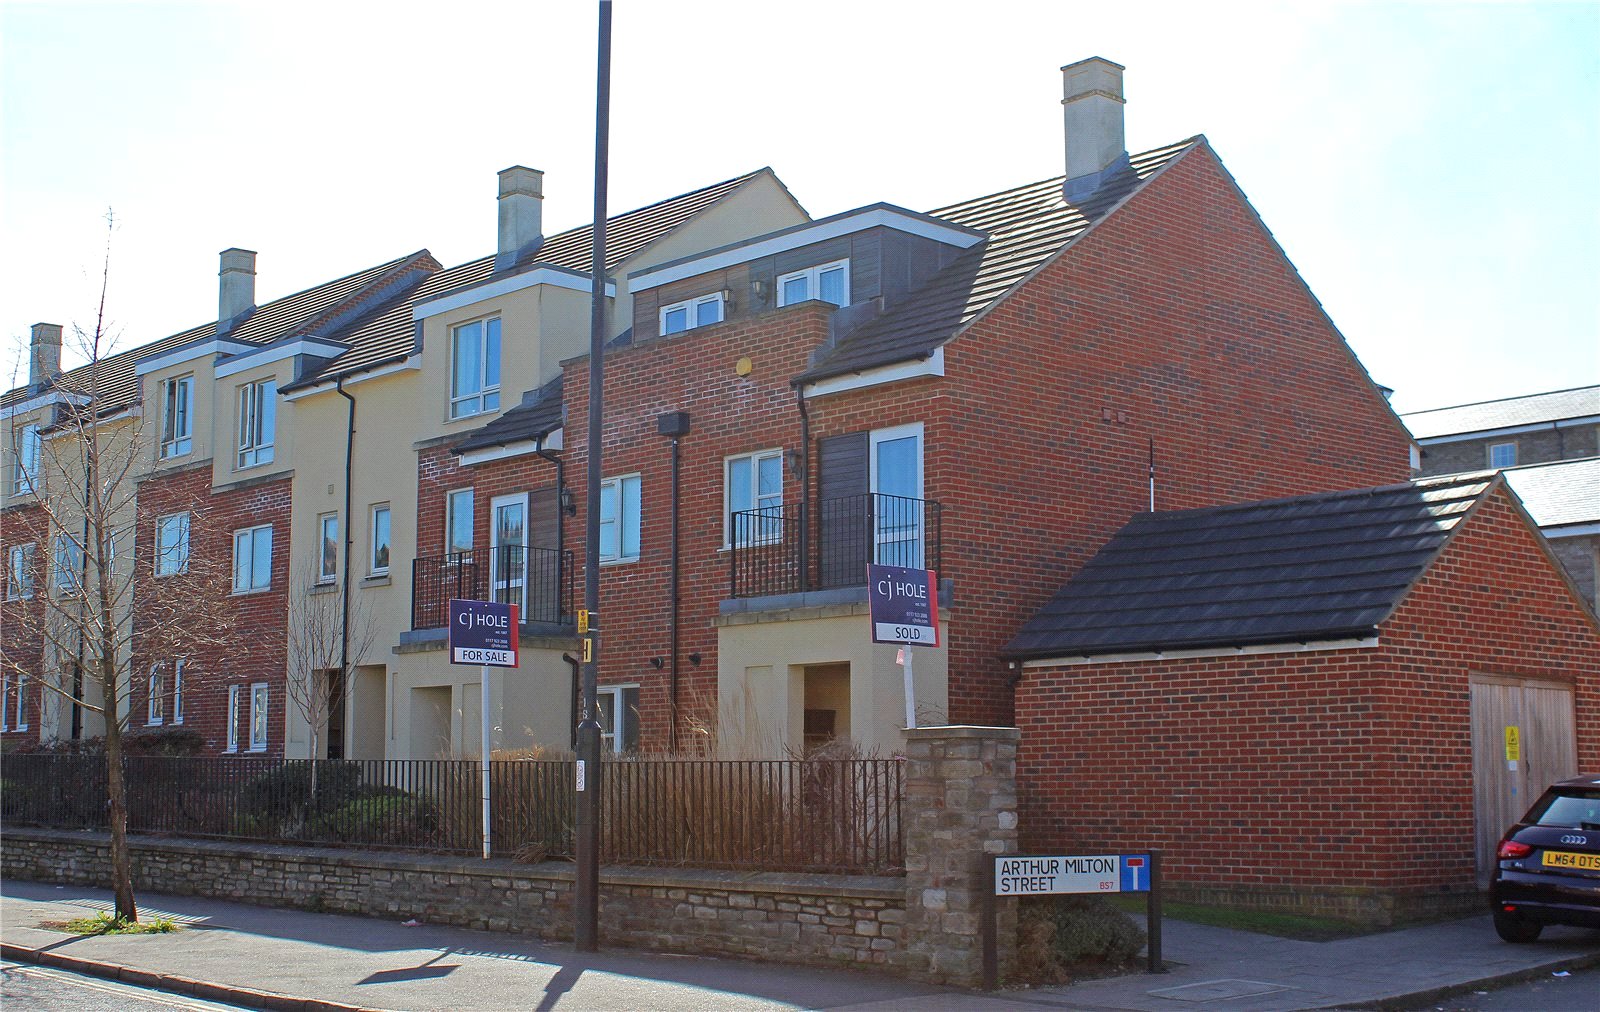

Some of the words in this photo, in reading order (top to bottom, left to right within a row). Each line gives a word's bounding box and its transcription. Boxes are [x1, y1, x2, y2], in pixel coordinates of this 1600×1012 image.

[896, 582, 927, 599] HOLE
[476, 613, 508, 628] HOLE
[895, 626, 920, 640] SOLD
[462, 650, 483, 661] FOR
[485, 651, 508, 663] SALE
[1001, 859, 1059, 876] ARTHUR
[1065, 858, 1114, 874] MILTON
[1547, 853, 1576, 866] LM64
[1001, 876, 1056, 893] STREET
[1099, 881, 1114, 890] BS7
